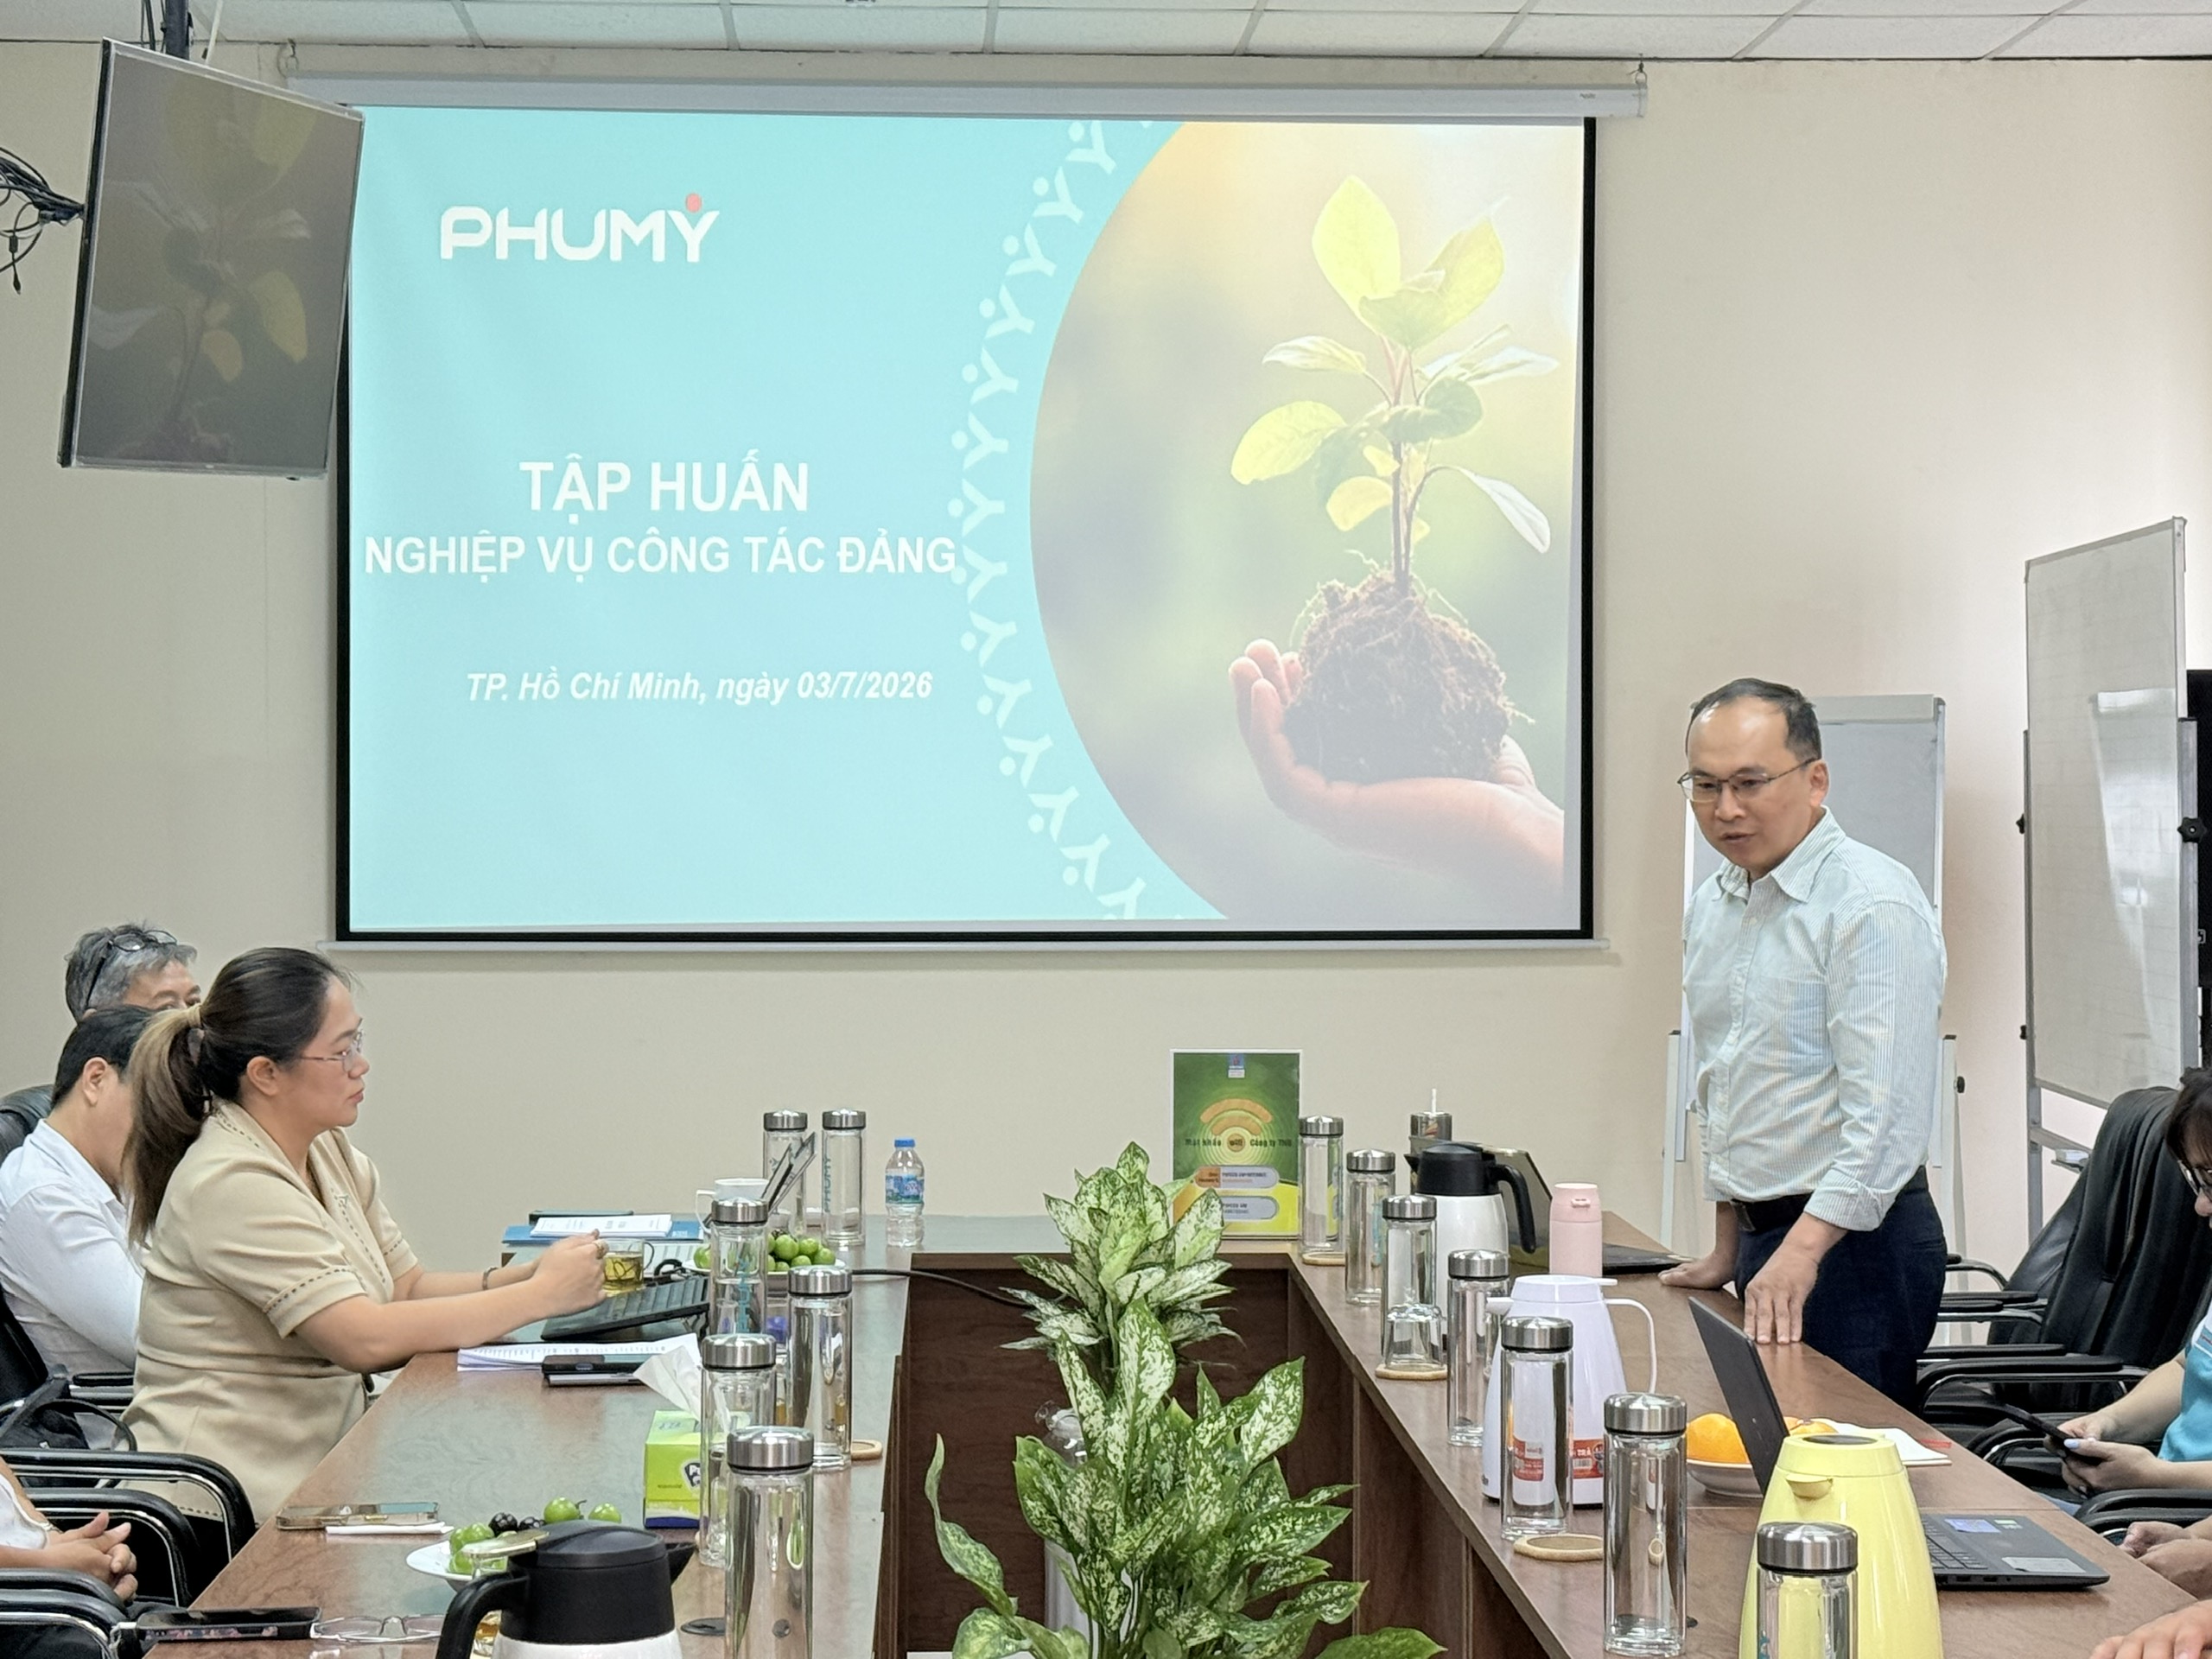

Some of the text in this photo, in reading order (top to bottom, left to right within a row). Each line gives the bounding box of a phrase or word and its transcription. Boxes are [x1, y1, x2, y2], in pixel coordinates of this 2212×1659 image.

[442, 194, 719, 263] PHUMY
[520, 449, 809, 524] TẬP HUẤN
[365, 527, 956, 582] NGHIỆP VỤ CÔNG TÁC ĐẢNG
[467, 666, 932, 706] TP. Hồ Chí Minh, ngày 03/7/2026
